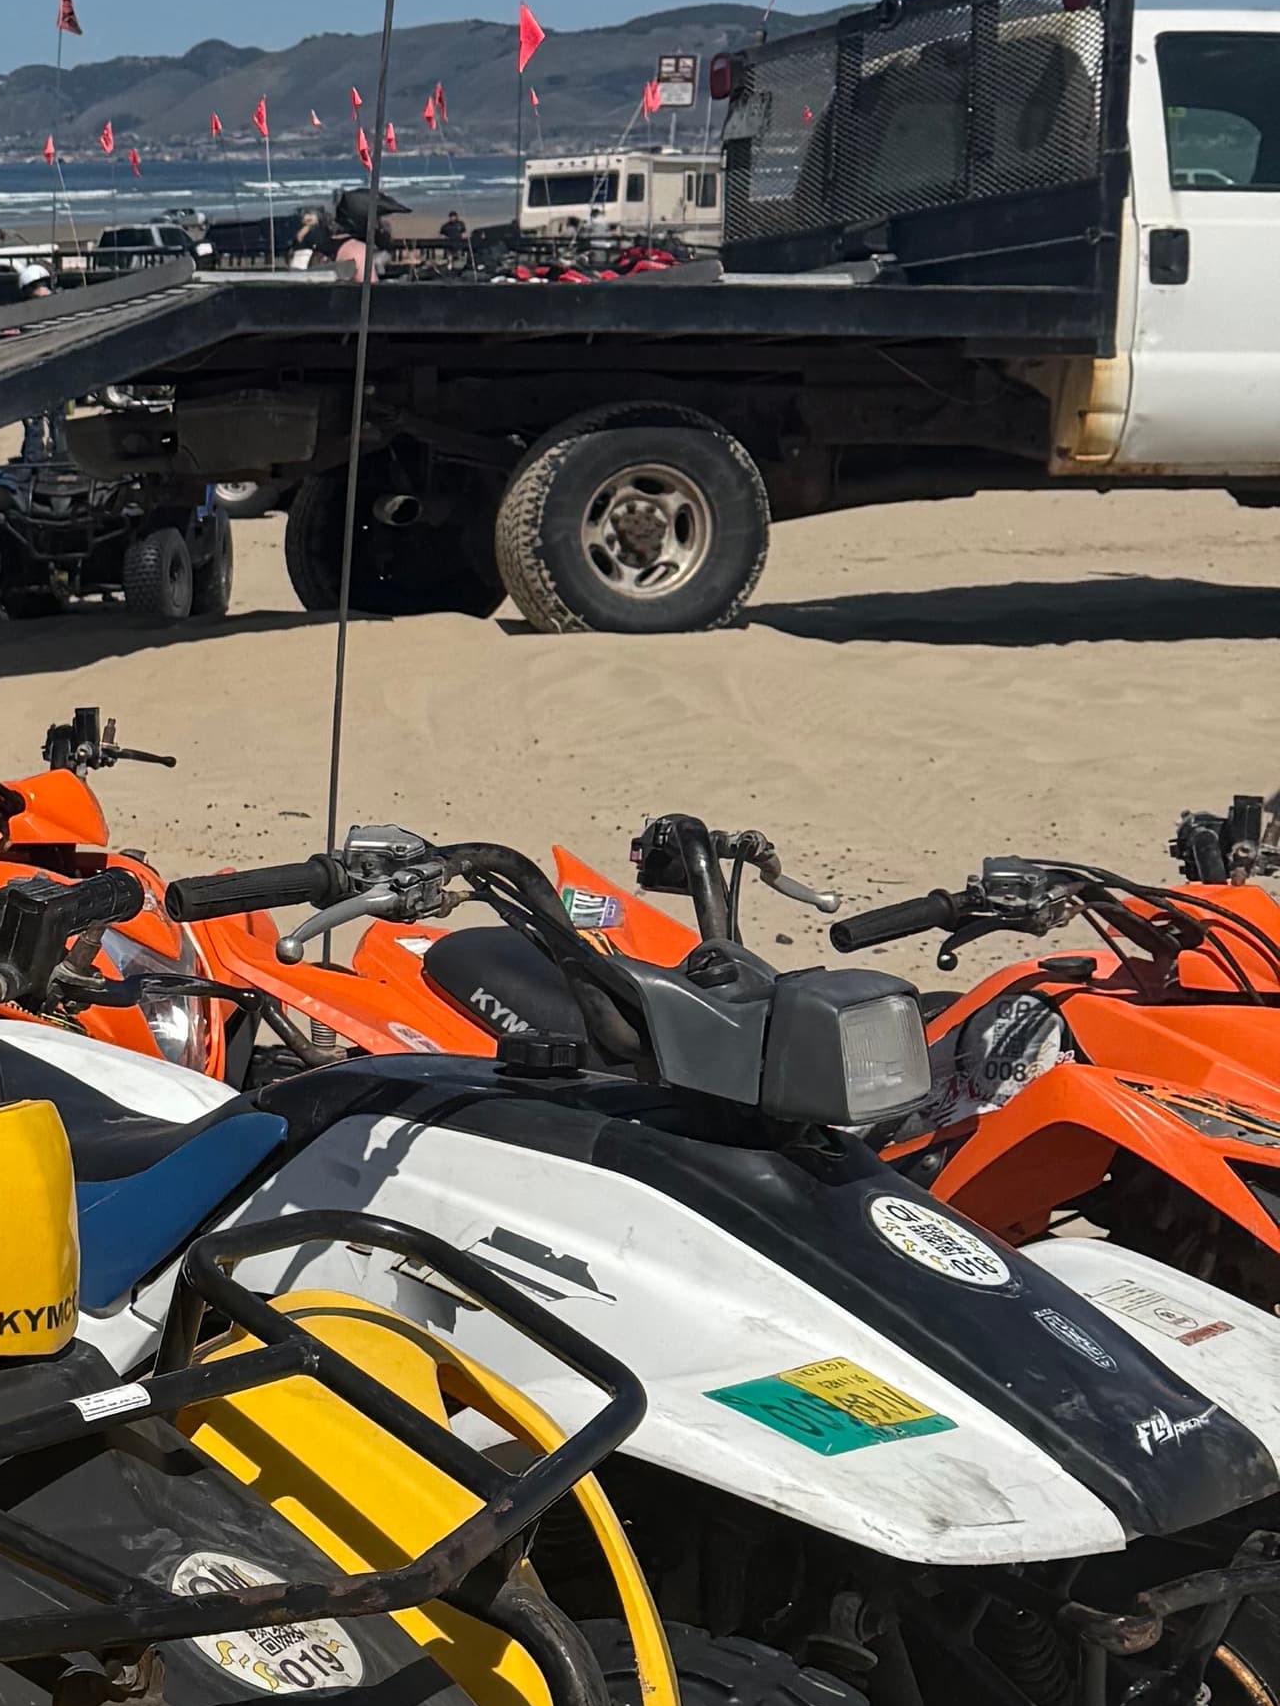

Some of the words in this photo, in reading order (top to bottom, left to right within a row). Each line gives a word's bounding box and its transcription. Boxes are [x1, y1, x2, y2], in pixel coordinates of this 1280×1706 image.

[469, 986, 539, 1035] KYM
[985, 1060, 1027, 1082] 008
[951, 1256, 999, 1278] 018
[1136, 1405, 1174, 1457] FLY
[280, 1644, 345, 1688] 019
